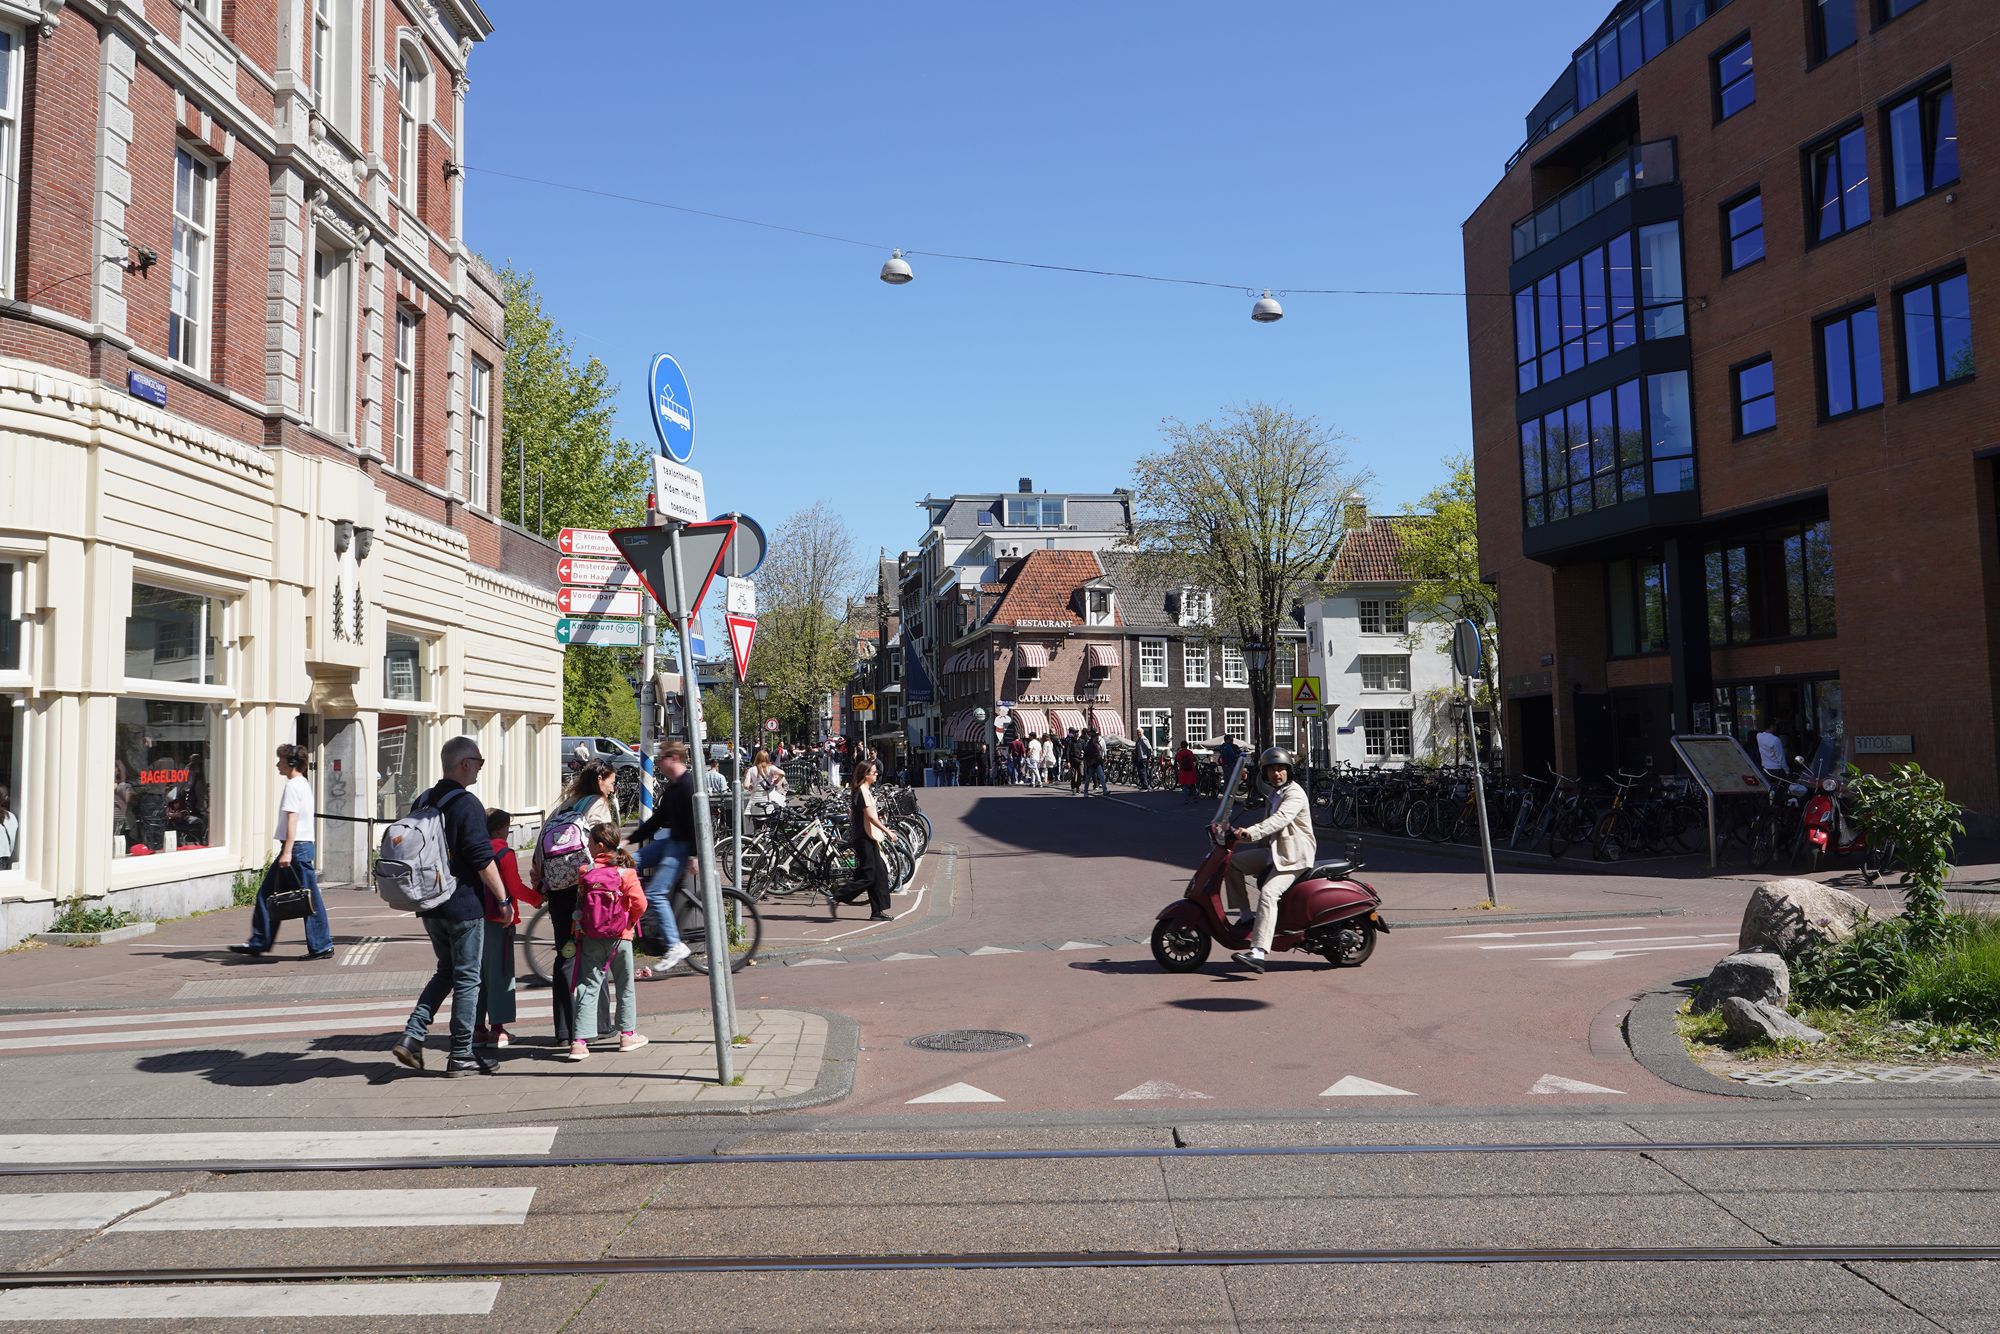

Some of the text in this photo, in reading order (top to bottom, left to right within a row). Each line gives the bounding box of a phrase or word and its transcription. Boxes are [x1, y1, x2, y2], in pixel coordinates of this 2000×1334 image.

[583, 533, 608, 541] Kleine-
[573, 572, 588, 580] Den
[572, 591, 615, 601] Vondelpark
[1016, 619, 1073, 628] RESTAURANT
[1041, 694, 1064, 702] HANS
[140, 769, 190, 784] BAGELBOY
